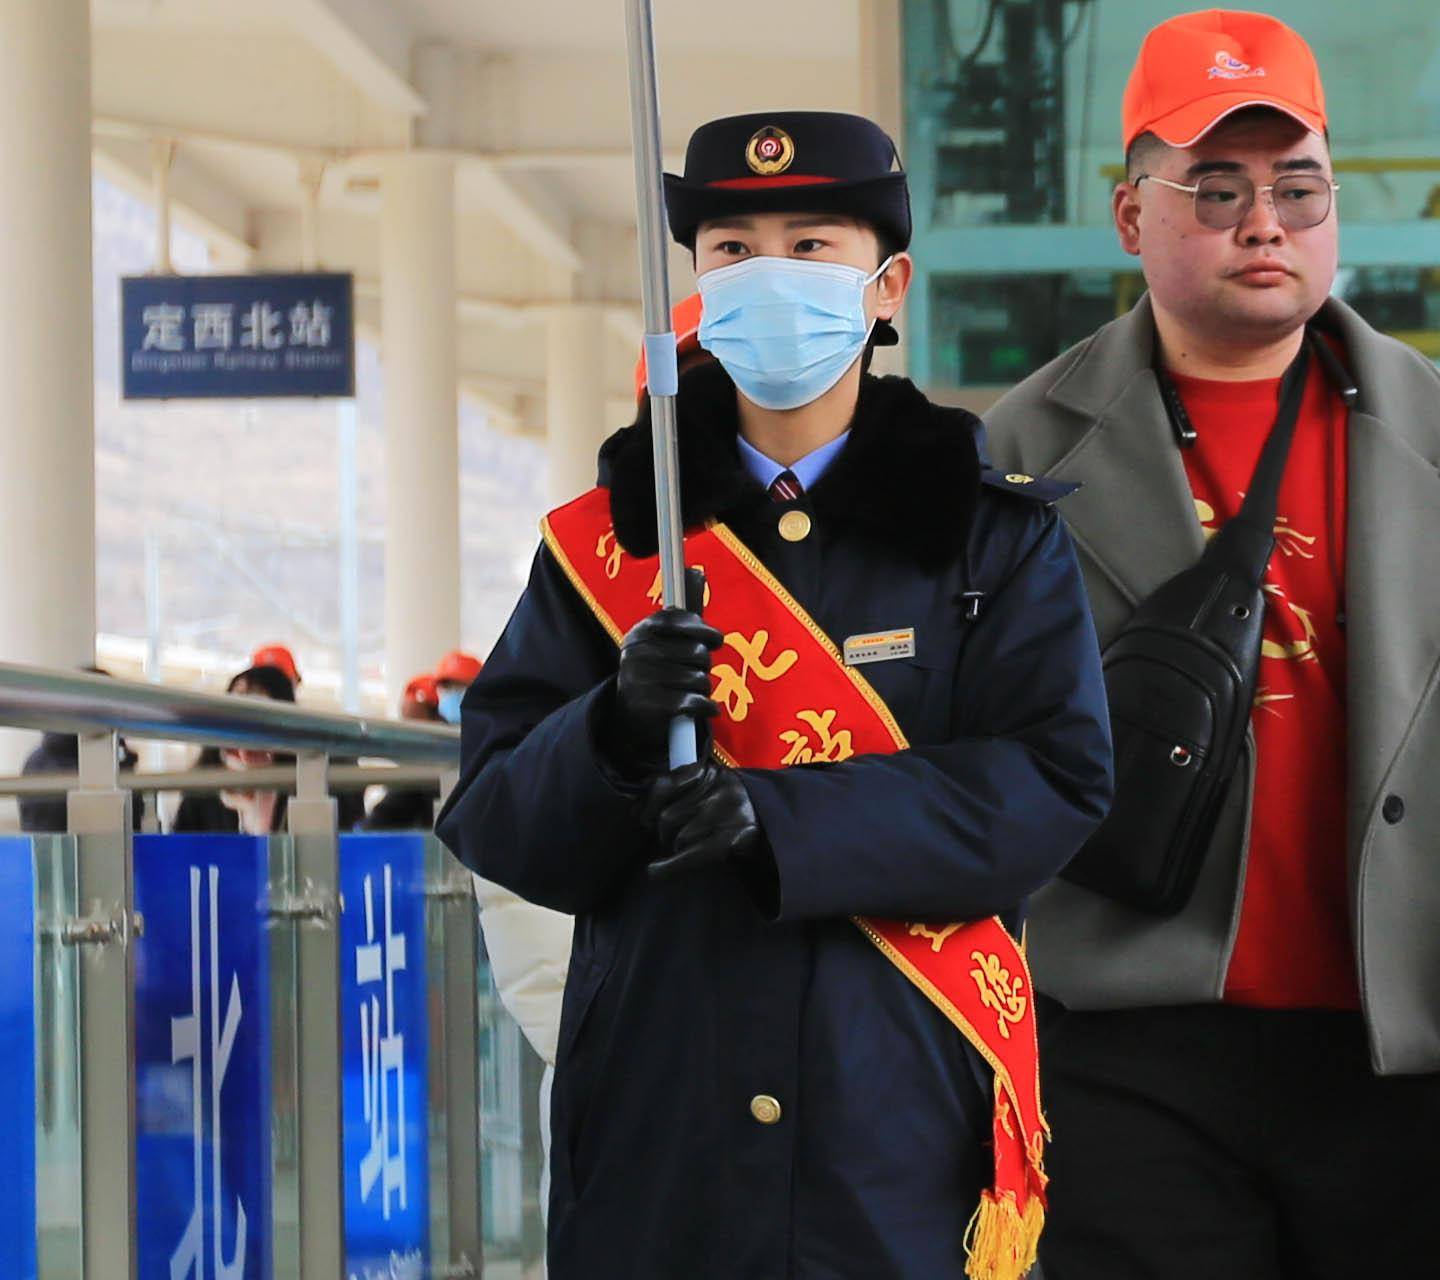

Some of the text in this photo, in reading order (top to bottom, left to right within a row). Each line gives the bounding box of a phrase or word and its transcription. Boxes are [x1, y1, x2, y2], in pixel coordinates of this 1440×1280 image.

[141, 297, 335, 352] 定西北站
[354, 864, 407, 1221] 站
